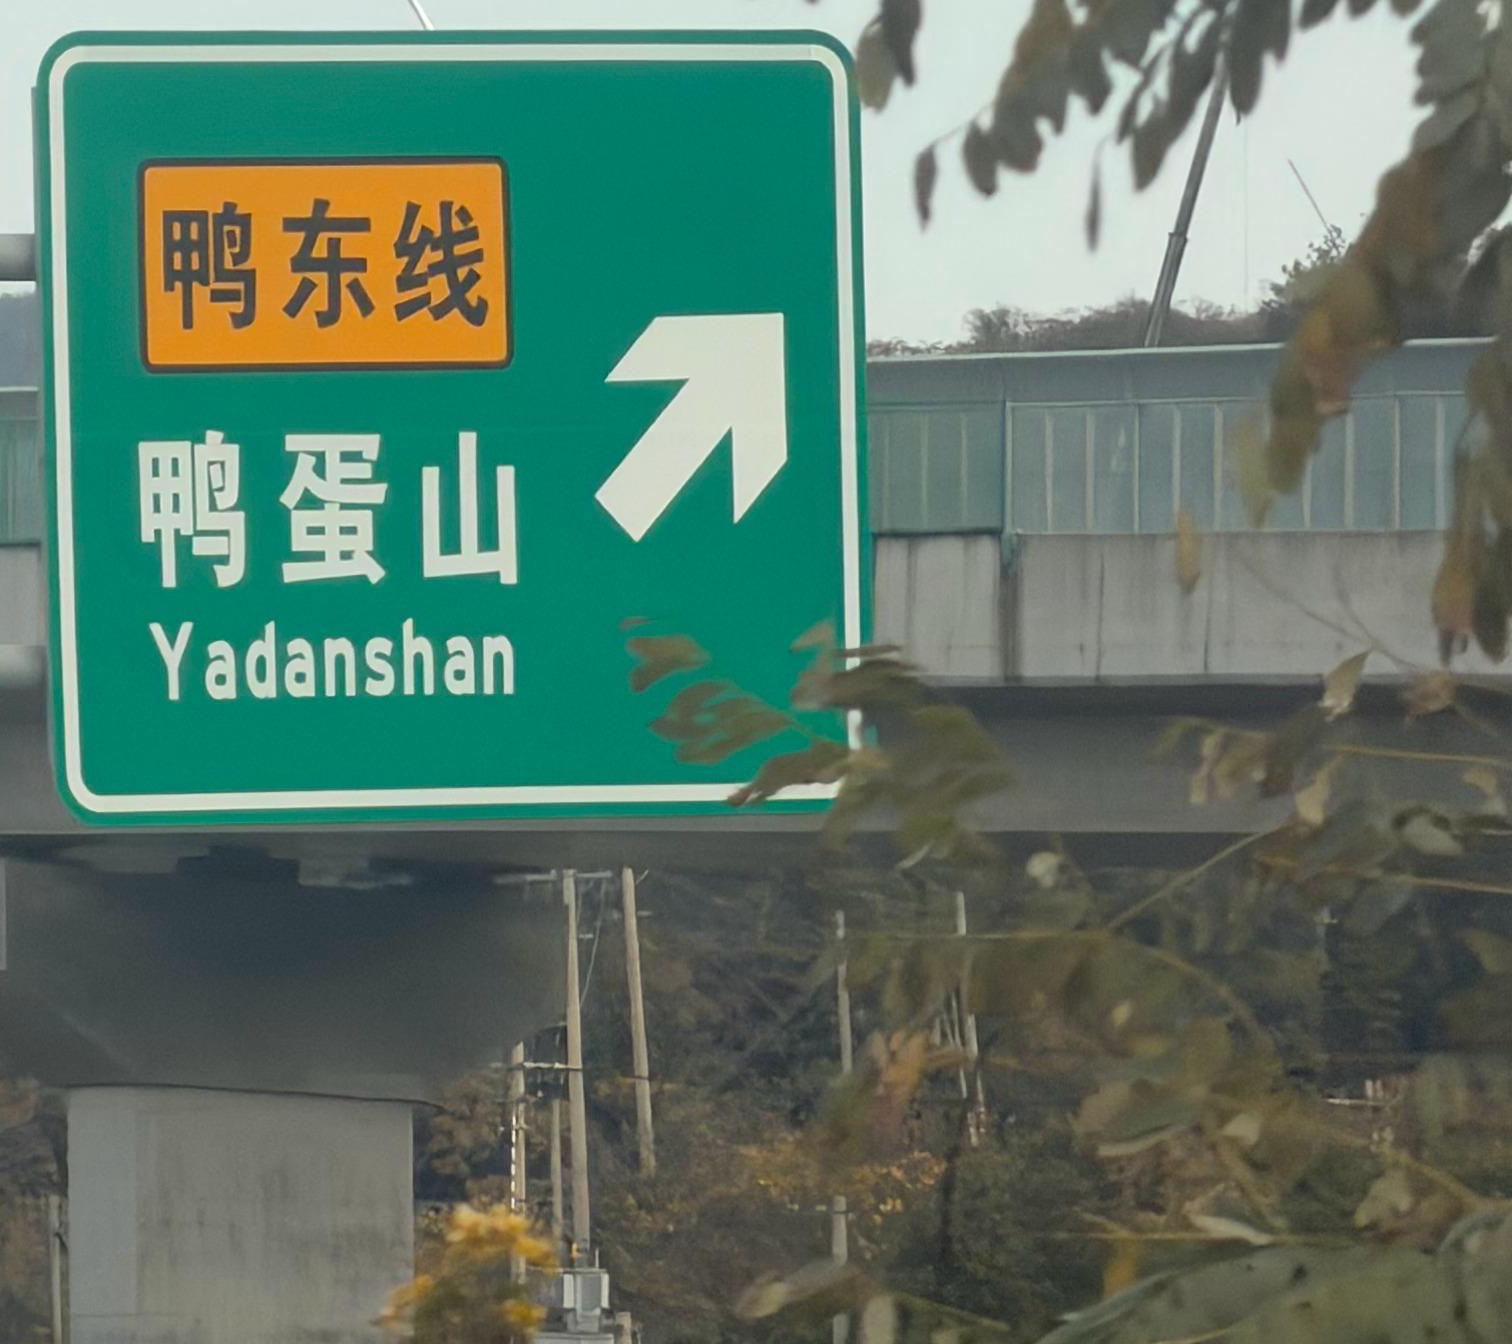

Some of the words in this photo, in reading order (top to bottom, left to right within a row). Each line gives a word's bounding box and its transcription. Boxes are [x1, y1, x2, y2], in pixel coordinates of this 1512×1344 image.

[161, 198, 489, 331] 鸭东线
[137, 429, 519, 589] 鸭蛋山
[149, 617, 515, 701] Yadanshan
